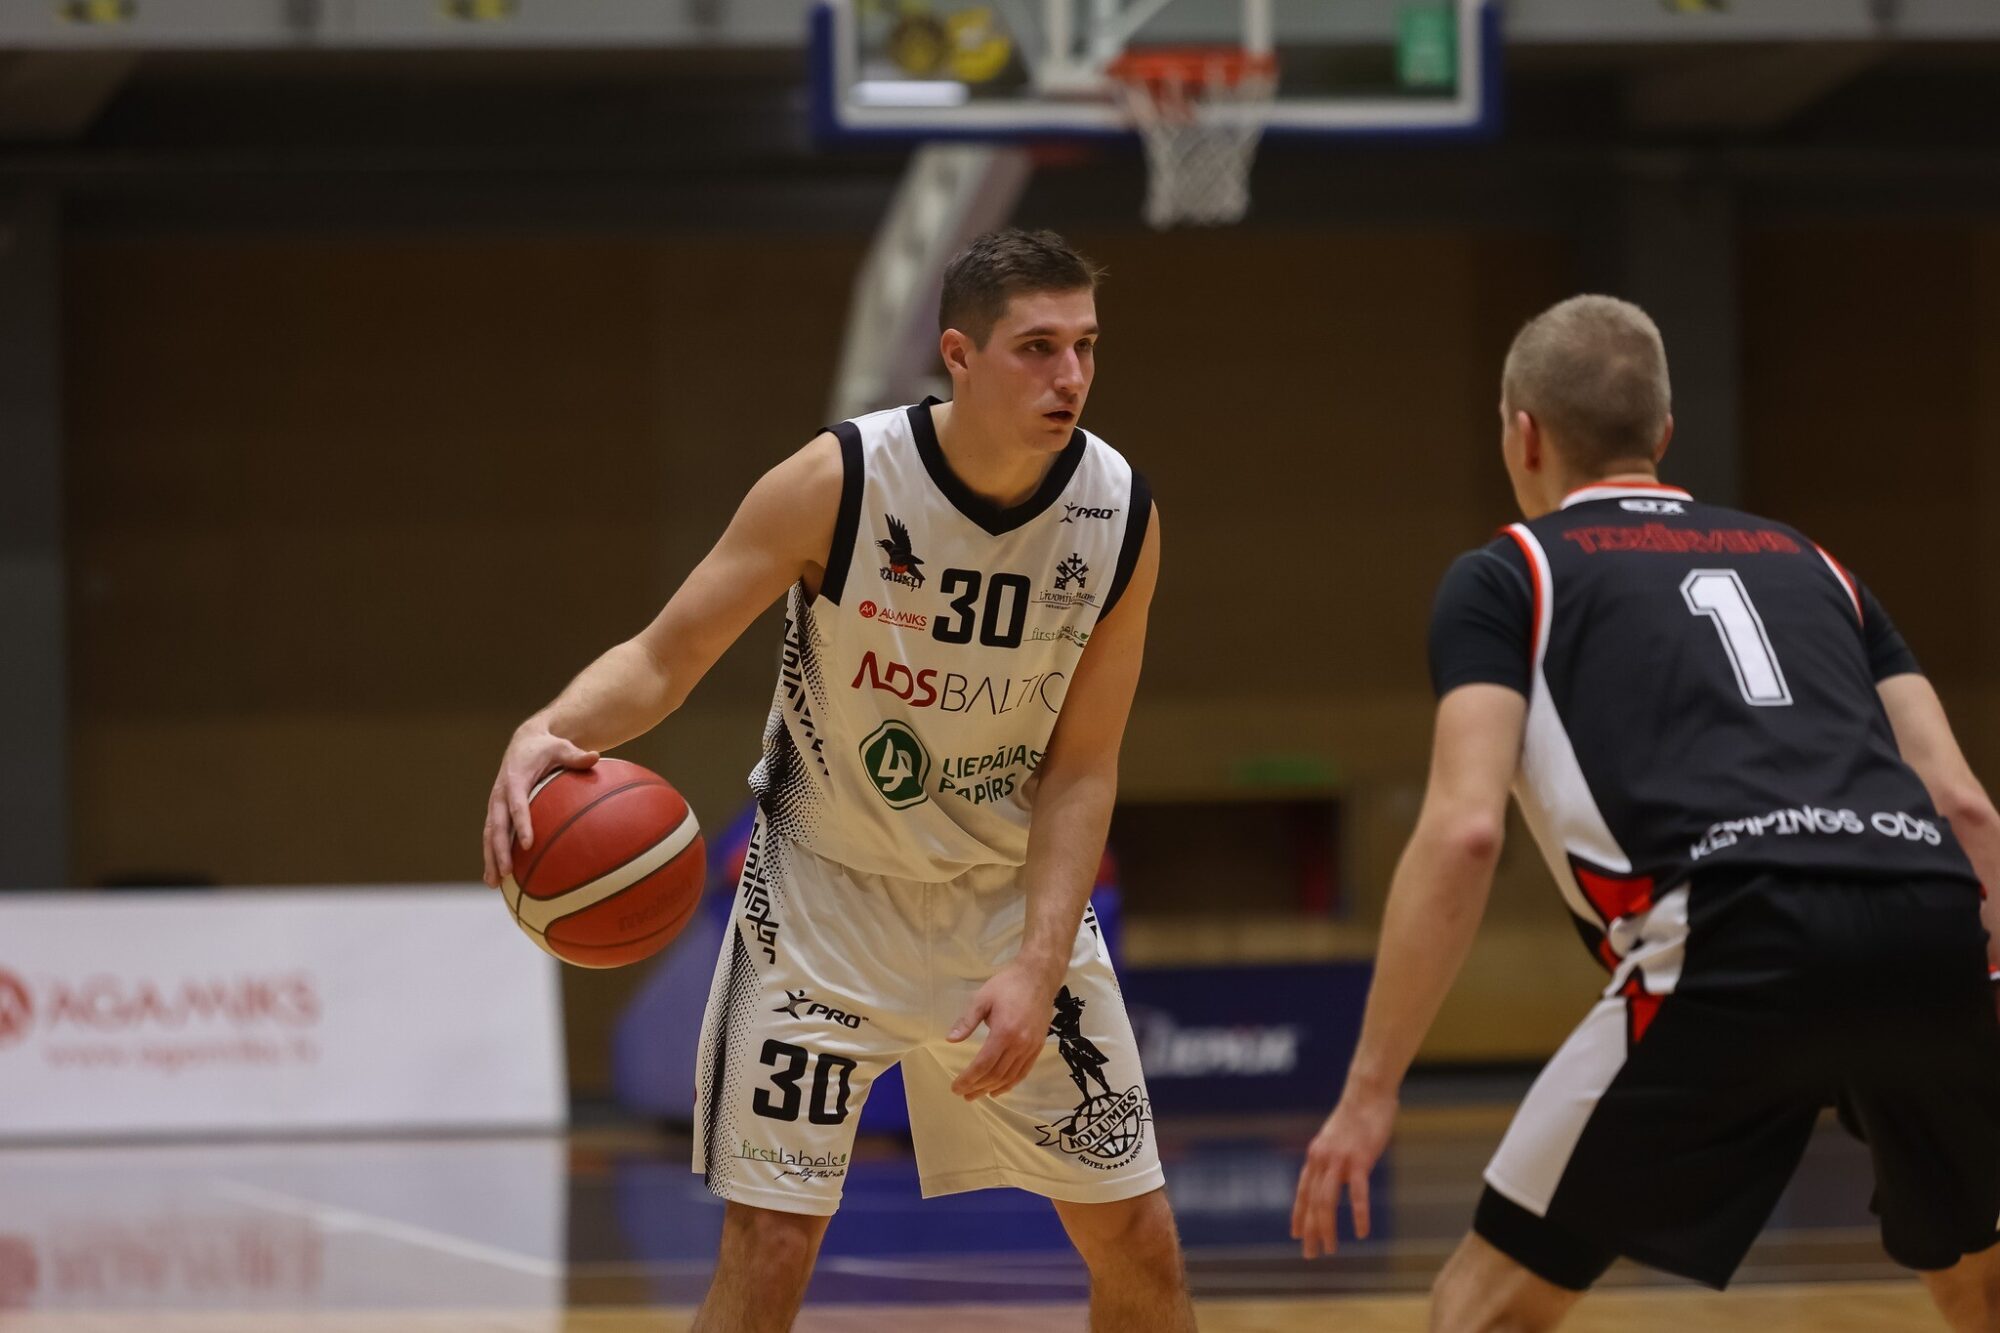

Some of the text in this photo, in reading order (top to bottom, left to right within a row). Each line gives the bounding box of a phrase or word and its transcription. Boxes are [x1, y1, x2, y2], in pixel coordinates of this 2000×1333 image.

[931, 567, 1031, 648] 30
[1678, 568, 1794, 706] 1
[938, 773, 1017, 805] PAPĪRS
[942, 744, 1046, 779] LIEPĀJAS
[1689, 804, 1942, 861] KEMPINGS ODS
[752, 1038, 858, 1126] 30
[1067, 1090, 1139, 1150] KOLUMBS
[741, 1139, 839, 1167] firstlabels
[1077, 1153, 1106, 1171] HOTEL
